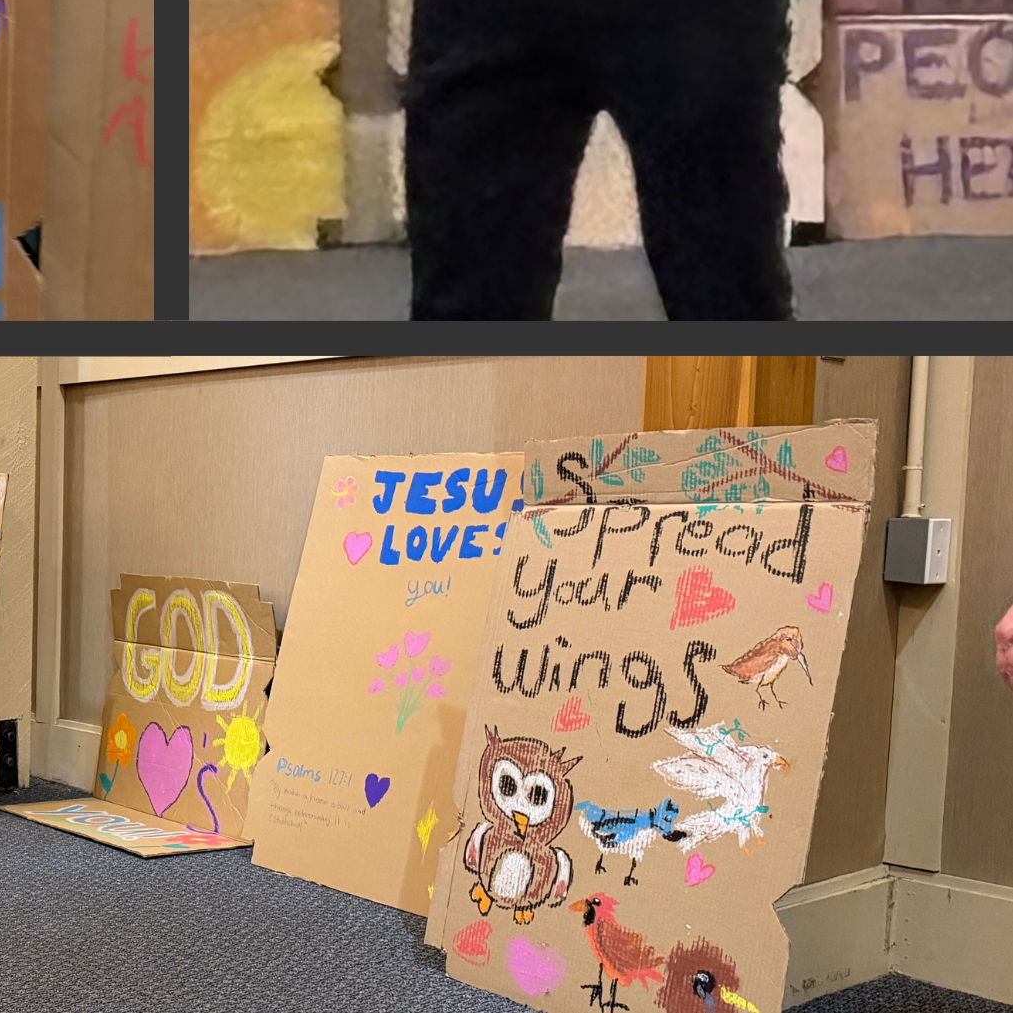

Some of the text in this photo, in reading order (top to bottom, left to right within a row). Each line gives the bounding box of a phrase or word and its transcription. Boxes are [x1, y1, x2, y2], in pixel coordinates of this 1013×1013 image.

[405, 575, 452, 607] you!
[506, 554, 664, 630] your
[121, 588, 253, 710] GOD
[277, 757, 353, 787] Psalms 127:1
[24, 804, 190, 841] YOU!
